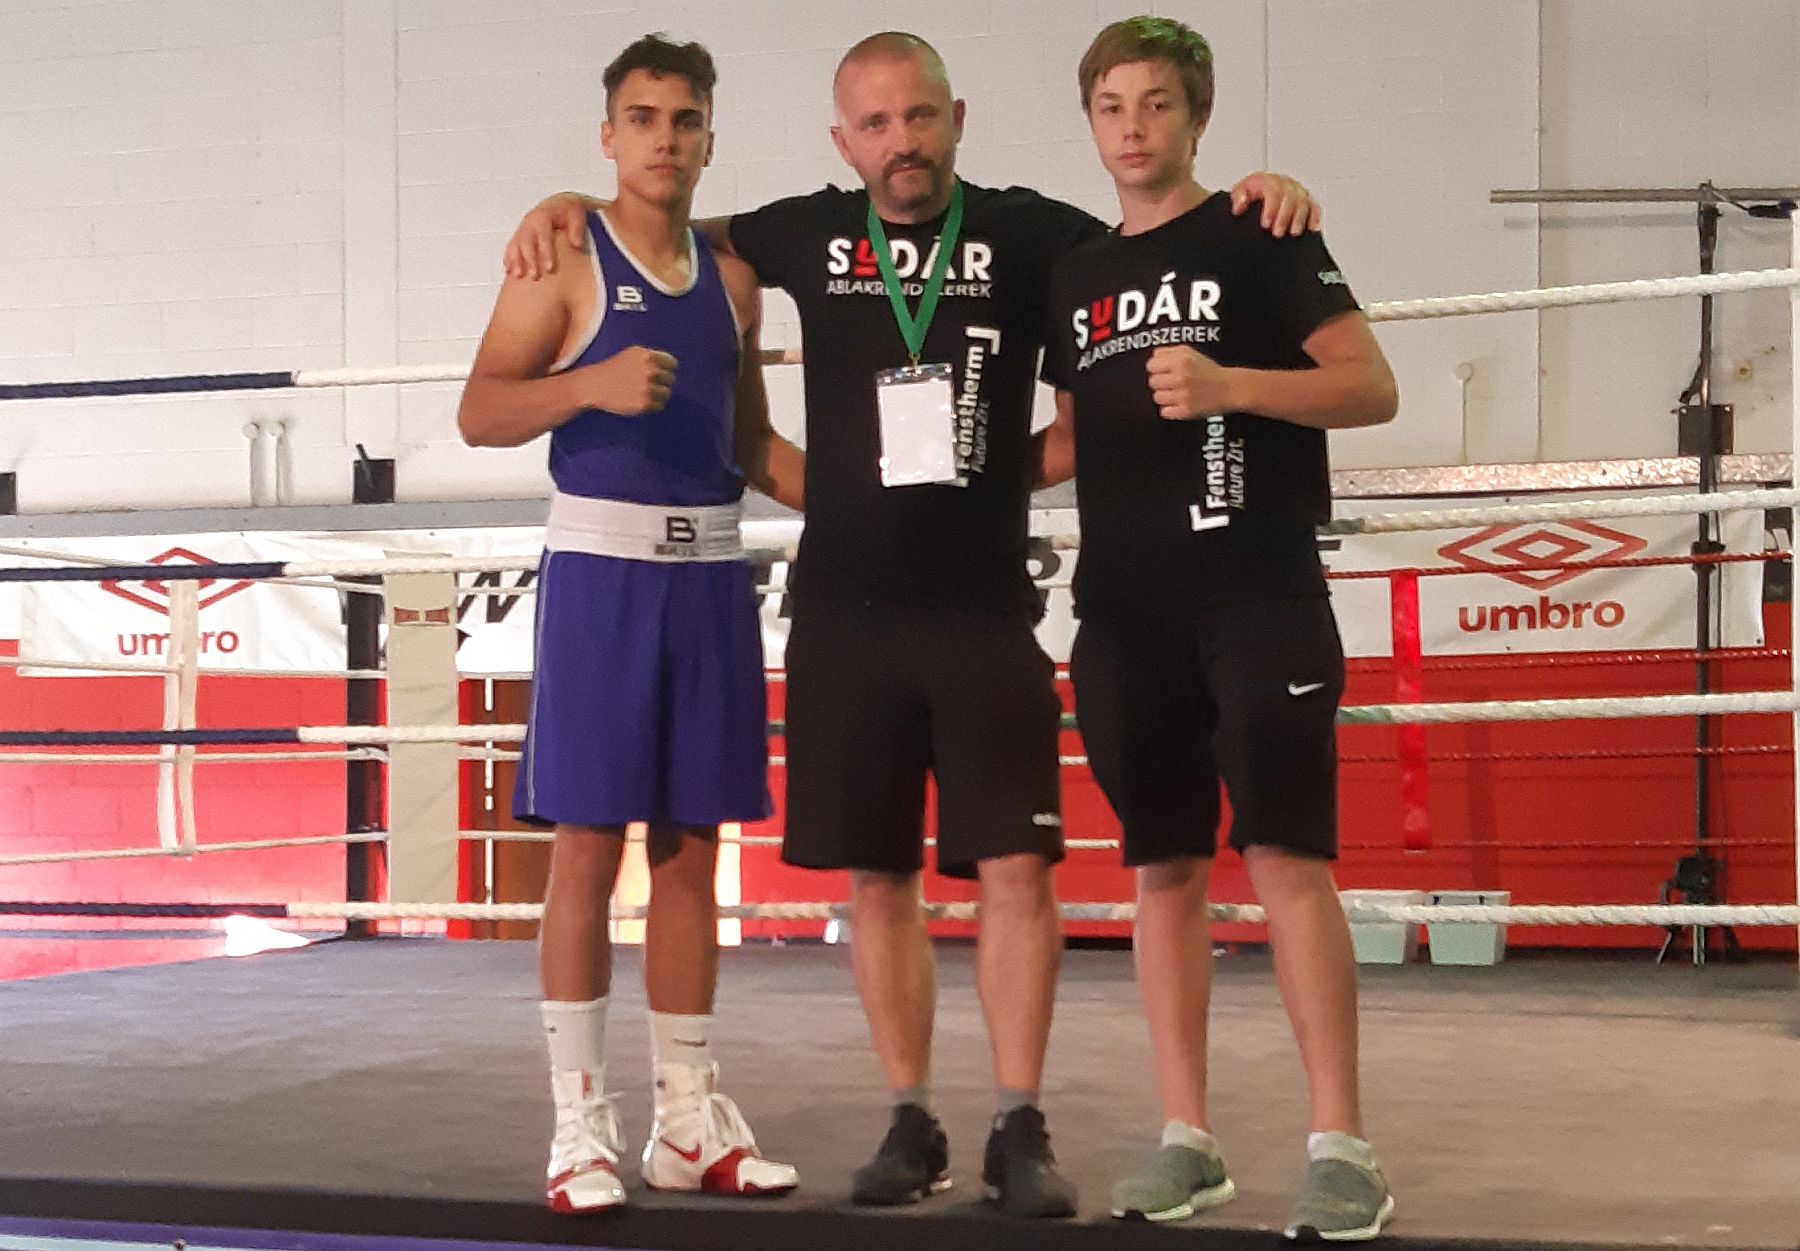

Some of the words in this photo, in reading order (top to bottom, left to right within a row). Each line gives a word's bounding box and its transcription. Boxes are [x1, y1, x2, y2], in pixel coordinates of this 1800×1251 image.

[1072, 271, 1221, 350] SUDÁR
[1459, 596, 1625, 632] umbro
[117, 631, 239, 656] umro
